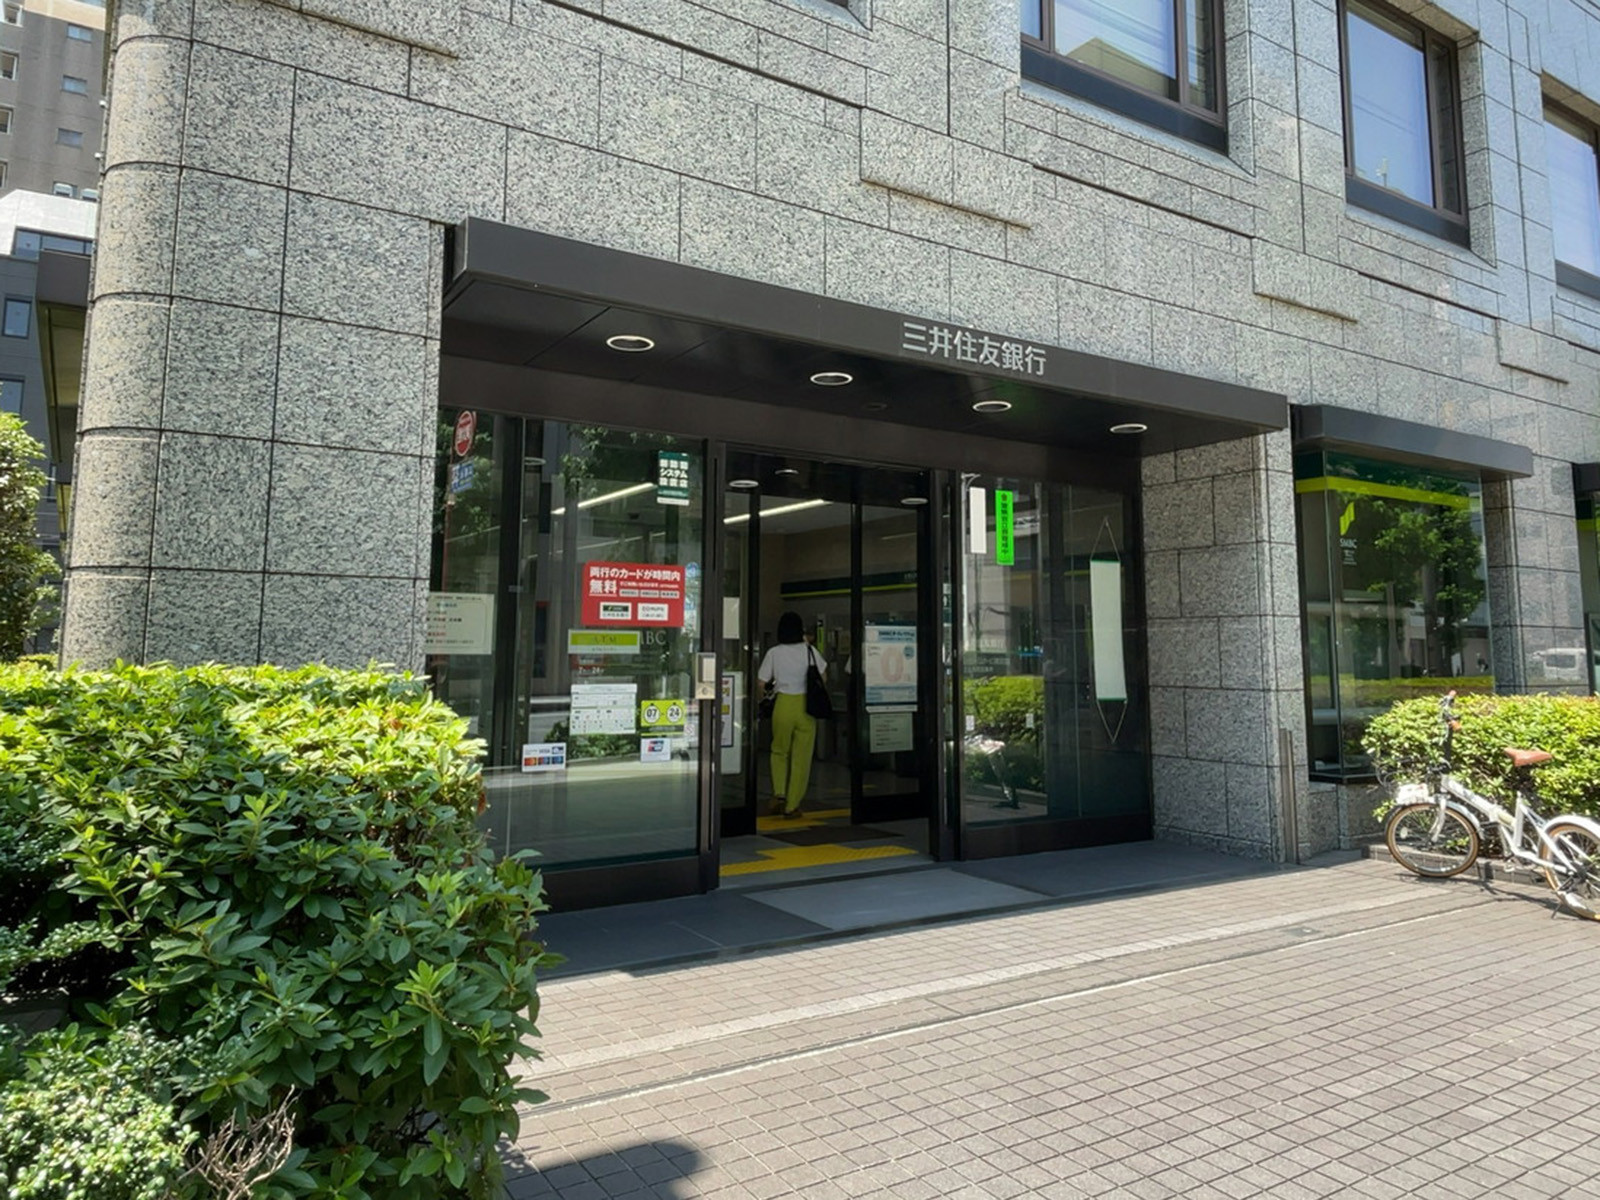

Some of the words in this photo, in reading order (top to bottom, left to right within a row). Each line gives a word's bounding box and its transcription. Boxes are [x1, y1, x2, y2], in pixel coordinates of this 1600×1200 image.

[902, 321, 1047, 376] 三井住友銀行
[589, 579, 617, 594] 無料
[646, 708, 658, 718] 07
[669, 707, 680, 717] 24
